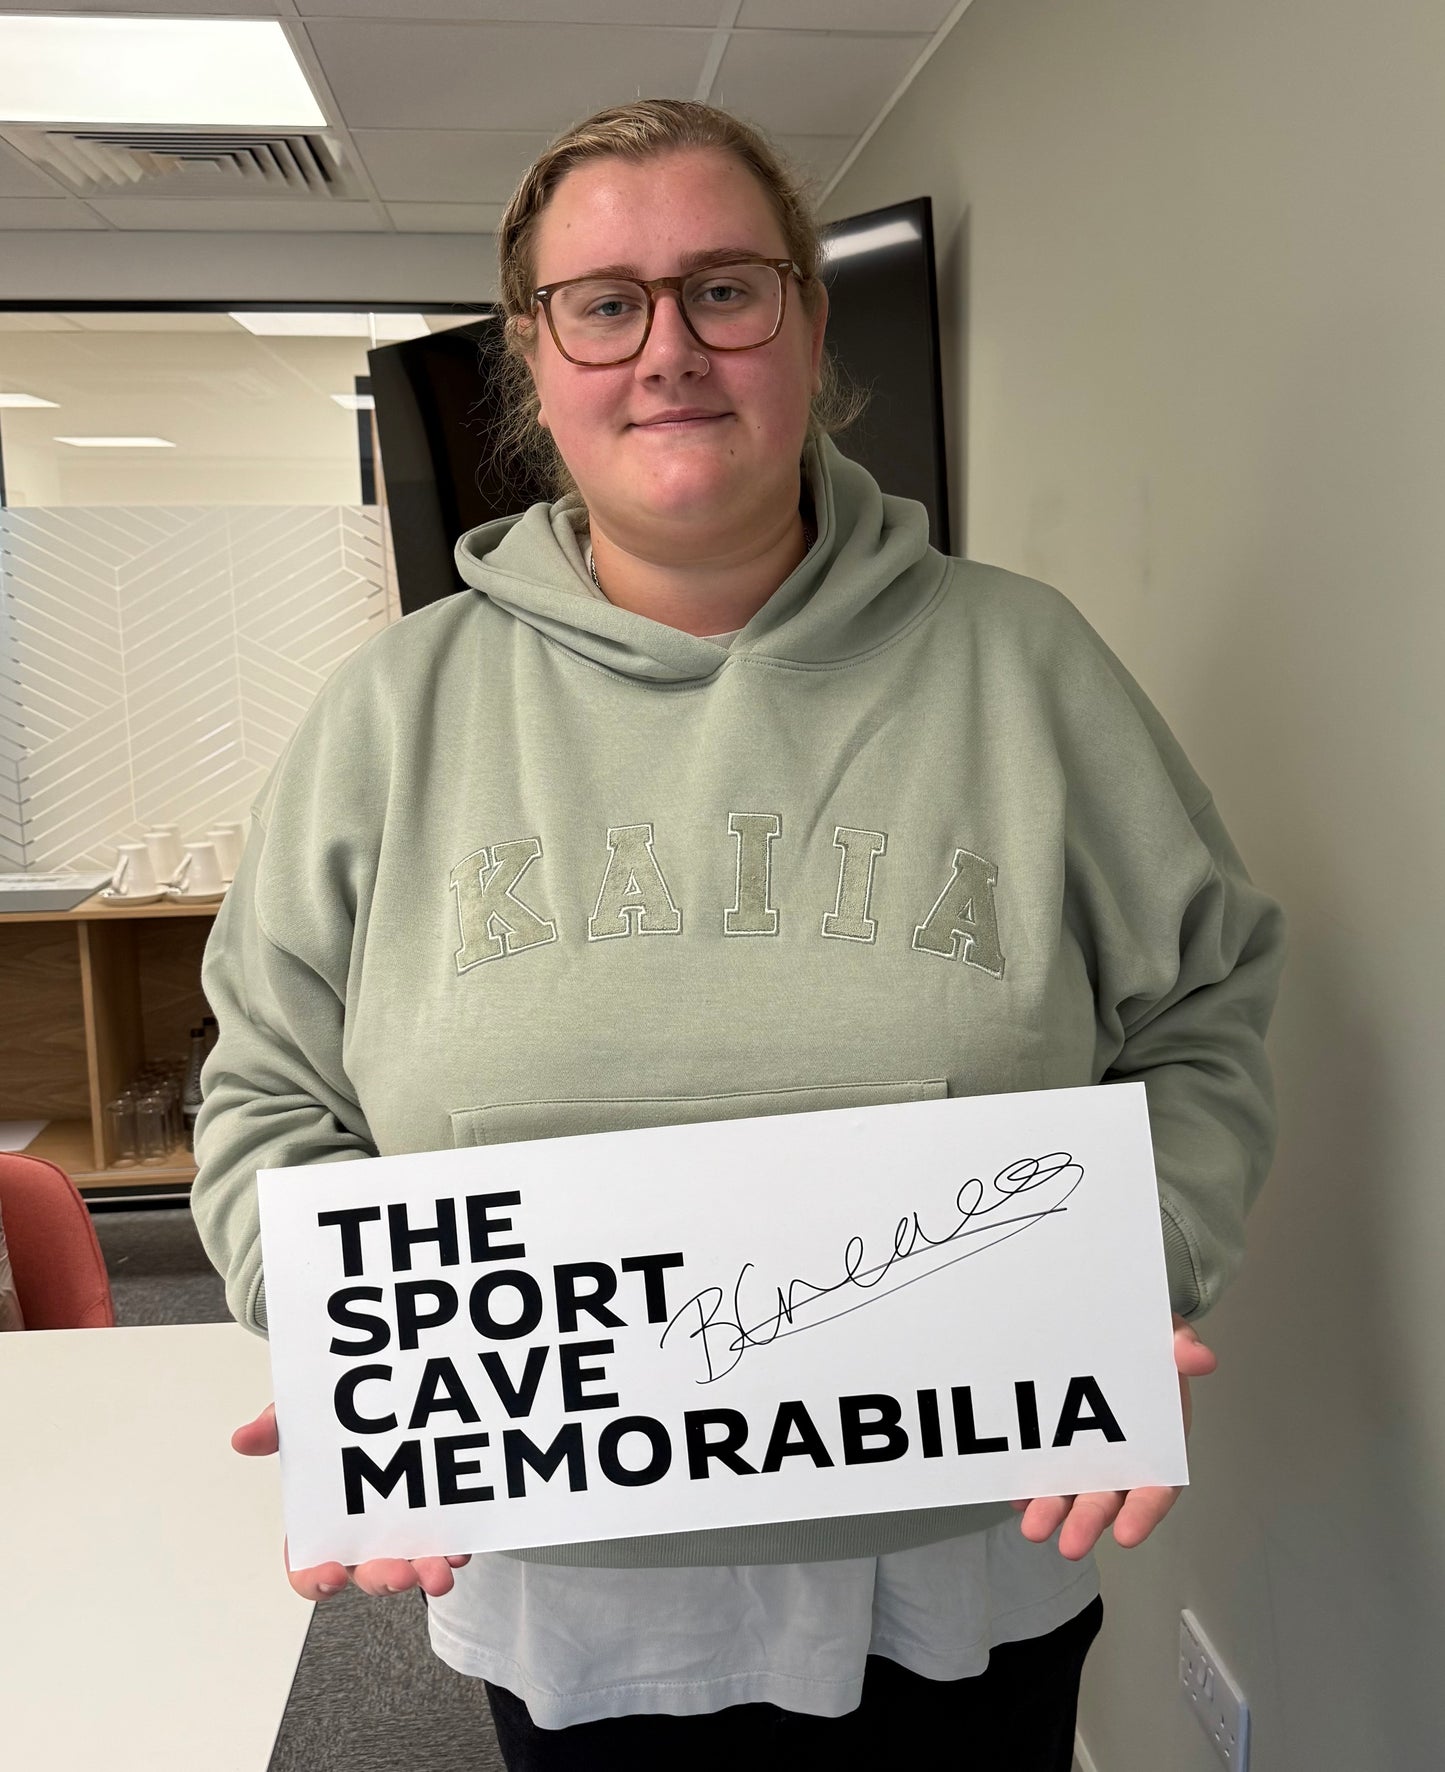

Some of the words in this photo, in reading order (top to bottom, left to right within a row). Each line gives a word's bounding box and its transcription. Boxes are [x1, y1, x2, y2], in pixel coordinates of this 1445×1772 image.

[449, 811, 1005, 979] KAIIA
[318, 1190, 526, 1278] THE
[328, 1251, 685, 1357] SPORT
[334, 1338, 620, 1435] CAVE
[341, 1375, 1127, 1516] MEMORABILIA
